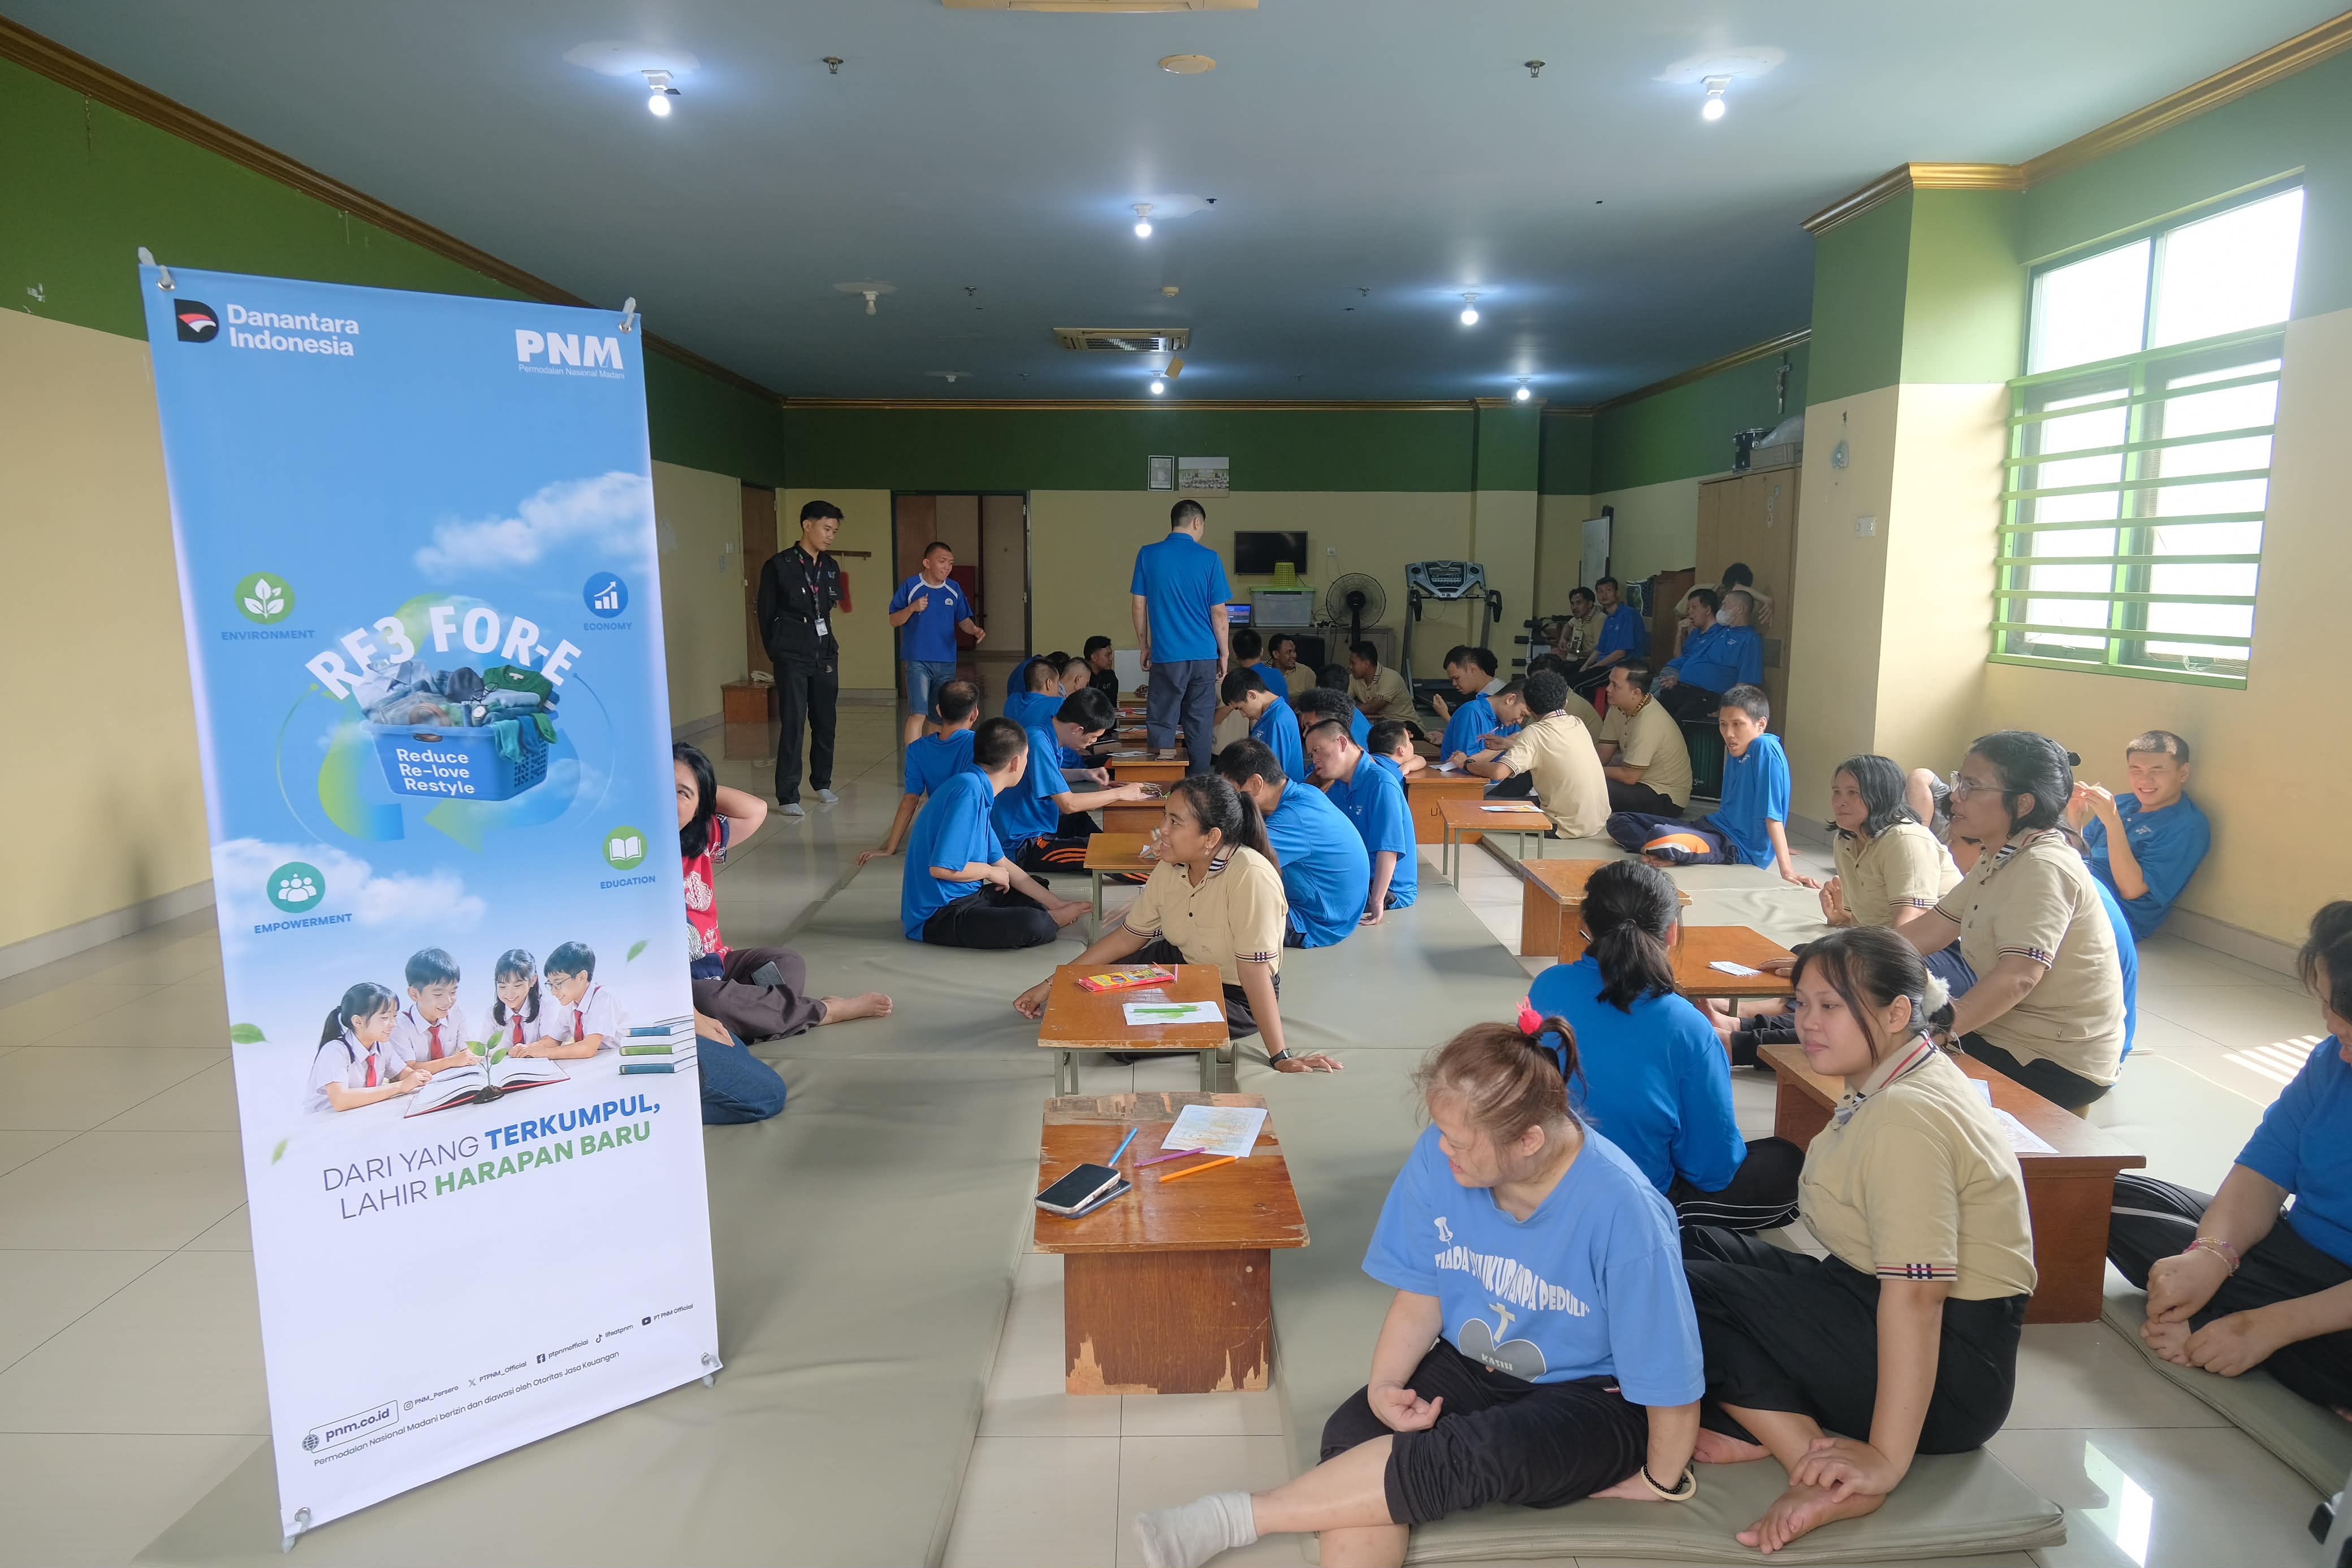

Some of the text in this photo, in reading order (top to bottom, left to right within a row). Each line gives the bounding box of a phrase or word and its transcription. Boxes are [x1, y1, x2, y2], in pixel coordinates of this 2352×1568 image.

[227, 304, 360, 335] Danantara
[230, 327, 354, 357] Indonesia
[515, 329, 624, 370] PNM
[518, 363, 625, 379] Permodalan Nasional Madani
[221, 629, 315, 641] ENVIRONMENT
[583, 622, 633, 631] ECONOMY
[429, 606, 582, 686] FOR-E
[396, 748, 469, 764] Reduce
[399, 763, 470, 778] Re-love
[404, 777, 475, 796] Restyle
[600, 876, 656, 890] EDUCATION
[254, 913, 352, 934] EMPOWERMENT
[323, 1094, 660, 1191] DARI YANG TERKUMPUL,
[340, 1121, 651, 1220] LAHIR HARAPAN BARU
[660, 1310, 673, 1319] PNM
[673, 1303, 694, 1314] Official
[605, 1324, 633, 1338] lifeatpnm
[548, 1339, 589, 1359] ptpnmofficial
[479, 1361, 527, 1382] PTPNM_Official
[1481, 1352, 1513, 1371] KASIH
[414, 1385, 459, 1405] PNM_Persero
[314, 1352, 619, 1467] Permodalan Nasional Madani berizin dan diawasi oleh Otoritas Jasa Keuangan
[325, 1408, 390, 1443] pnm.co.id
